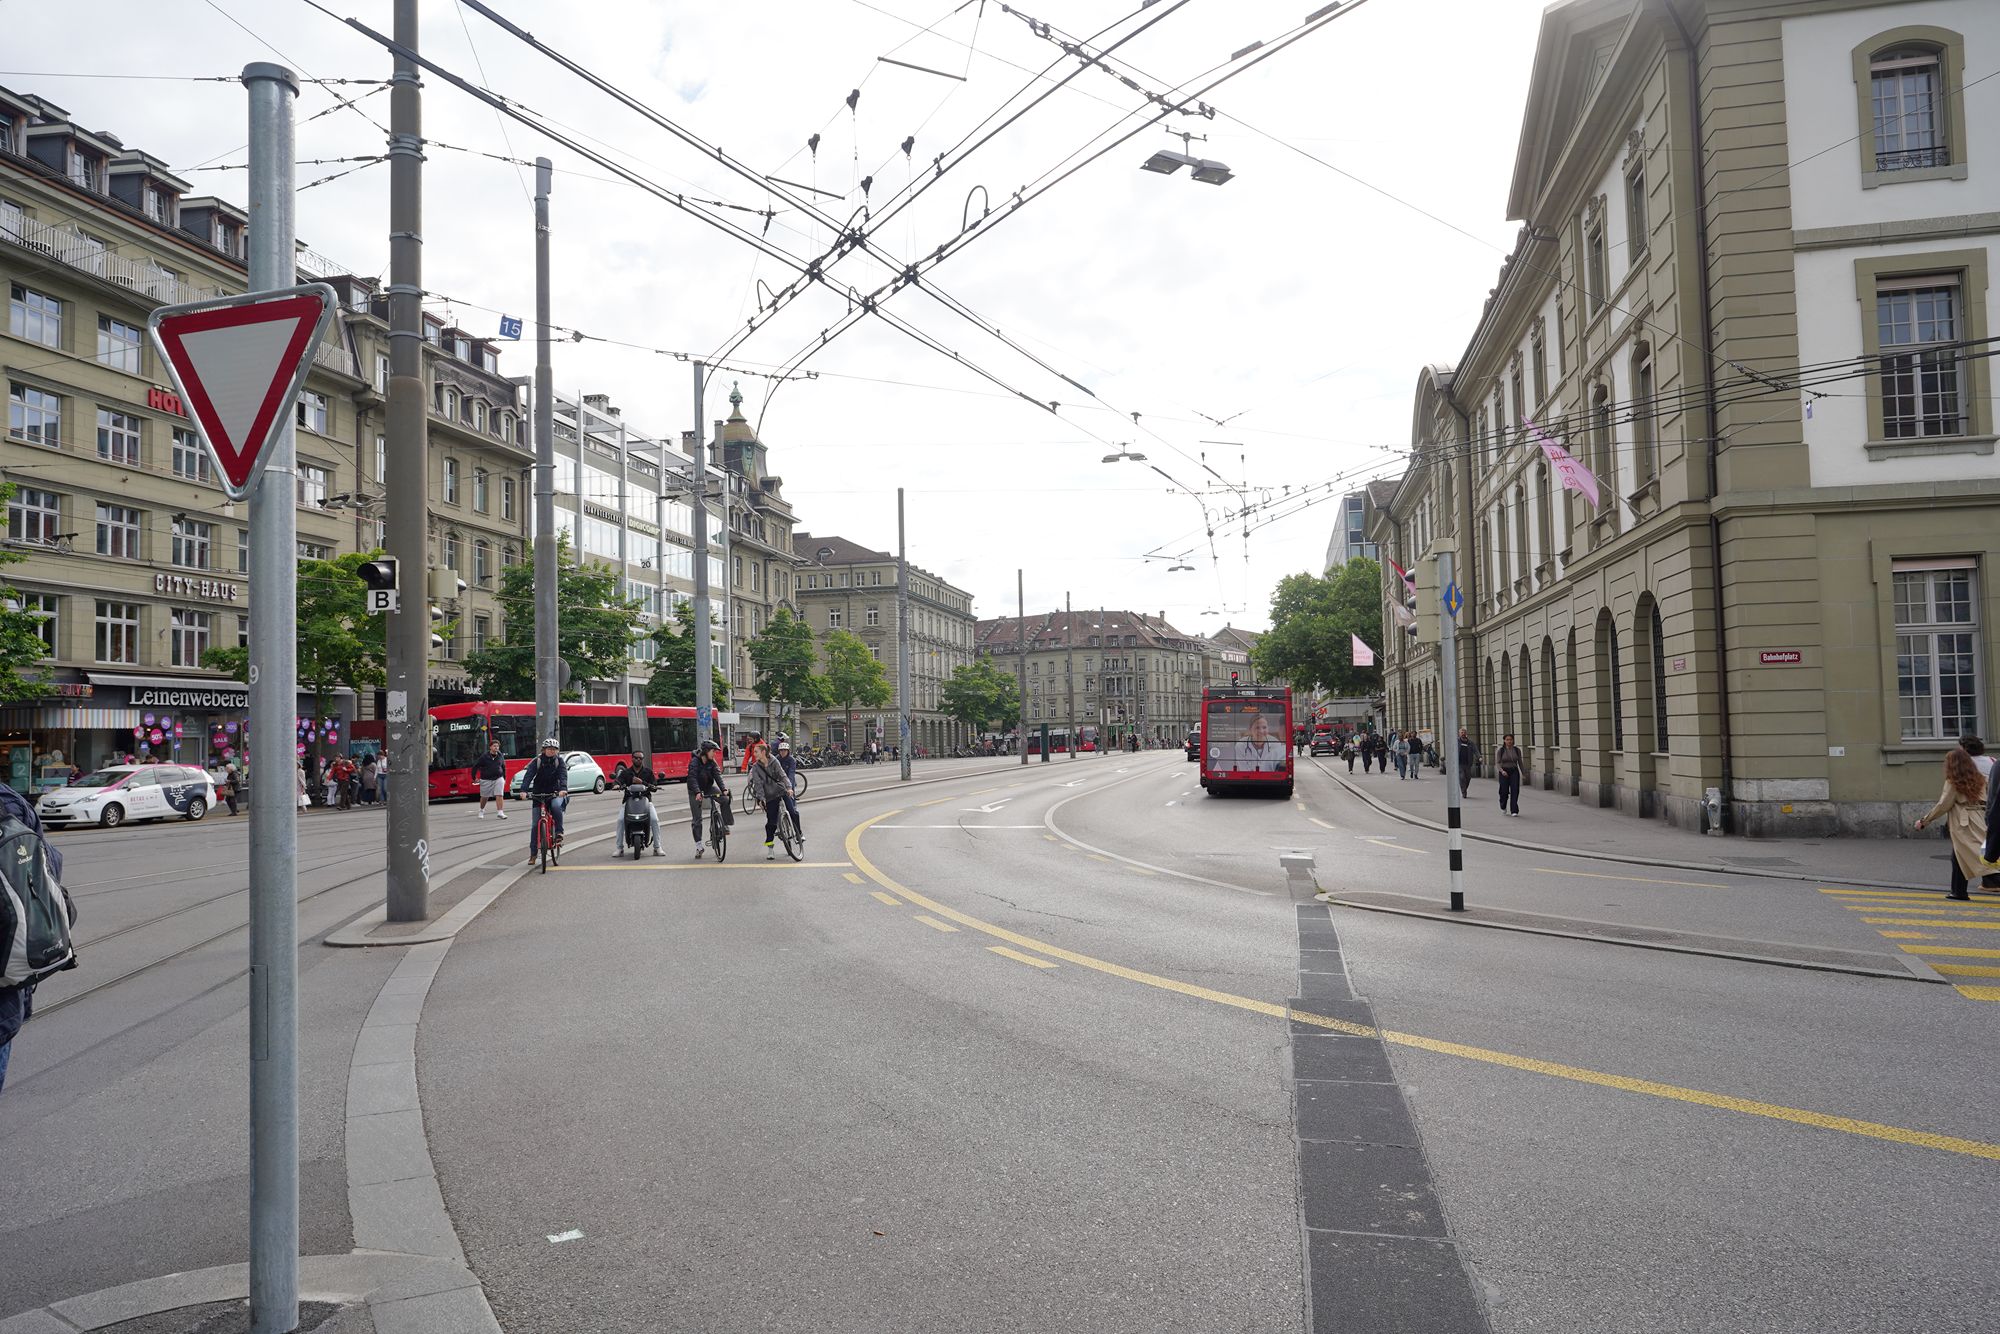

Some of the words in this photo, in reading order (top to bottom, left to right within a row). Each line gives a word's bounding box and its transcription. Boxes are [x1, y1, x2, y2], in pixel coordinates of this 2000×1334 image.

[502, 320, 521, 336] 15
[641, 561, 651, 569] 20
[155, 573, 238, 600] CITY-HAUS
[375, 591, 390, 609] B
[1762, 652, 1799, 662] Bahnhofplatz
[129, 686, 249, 708] Leinenweberei
[17, 765, 26, 775] 2
